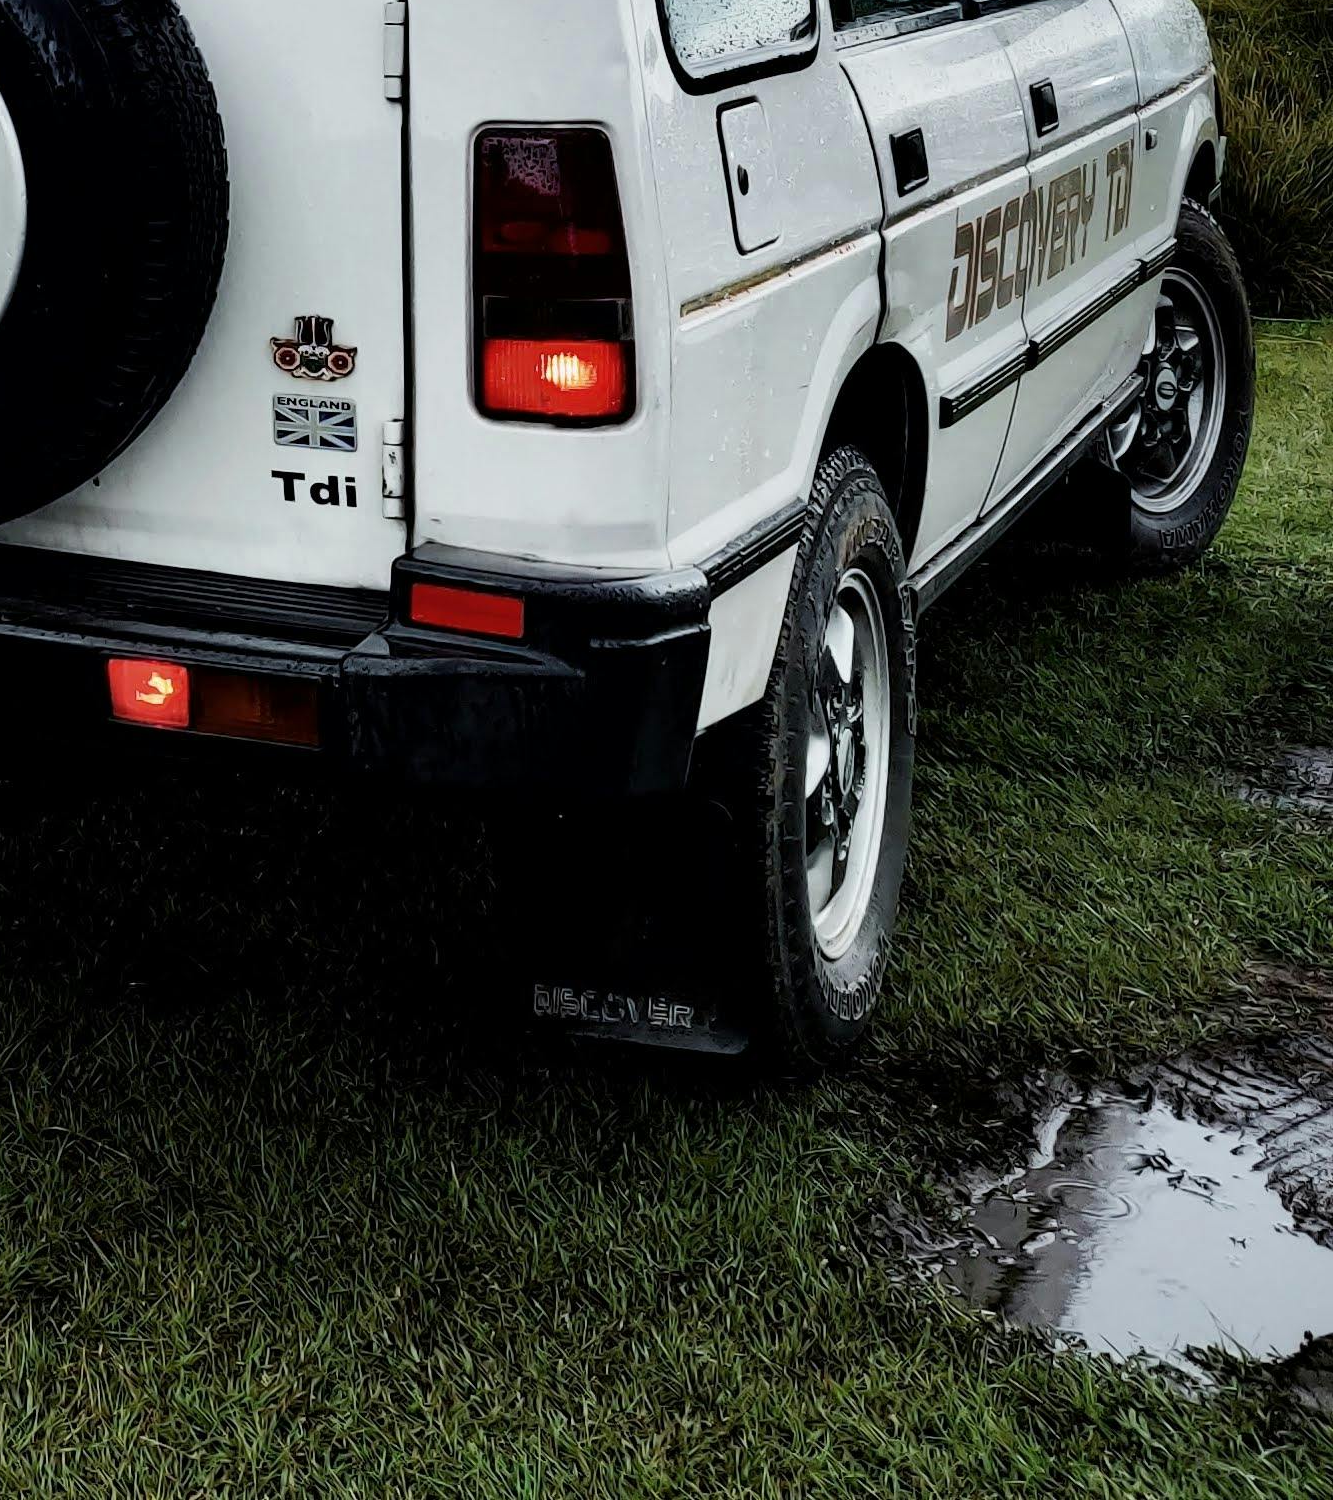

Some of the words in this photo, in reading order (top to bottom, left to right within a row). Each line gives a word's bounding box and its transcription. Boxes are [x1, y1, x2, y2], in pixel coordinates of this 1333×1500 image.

[944, 156, 1097, 343] DISCOVERY
[276, 396, 352, 412] ENGLAND
[270, 469, 358, 508] Tdi
[533, 982, 719, 1032] DISCOVER
